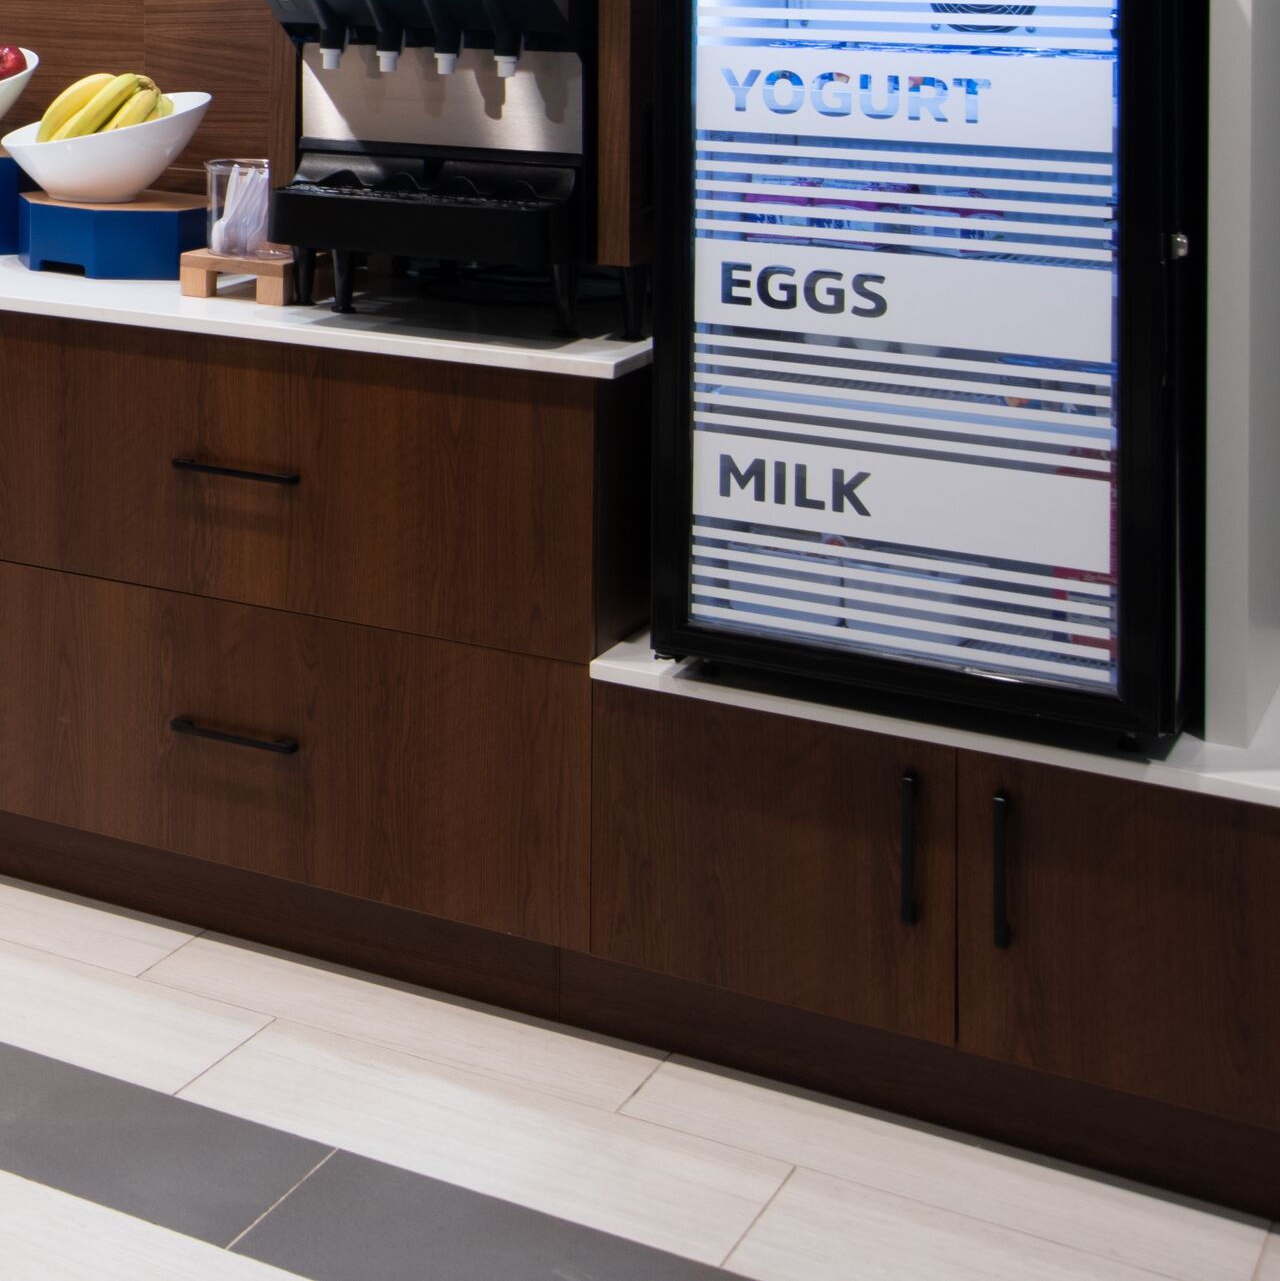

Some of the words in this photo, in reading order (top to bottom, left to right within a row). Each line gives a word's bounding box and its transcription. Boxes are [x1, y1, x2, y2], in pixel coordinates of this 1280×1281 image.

[721, 67, 992, 125] YOGURT
[720, 260, 889, 318] EGGS
[719, 453, 872, 518] MILK
